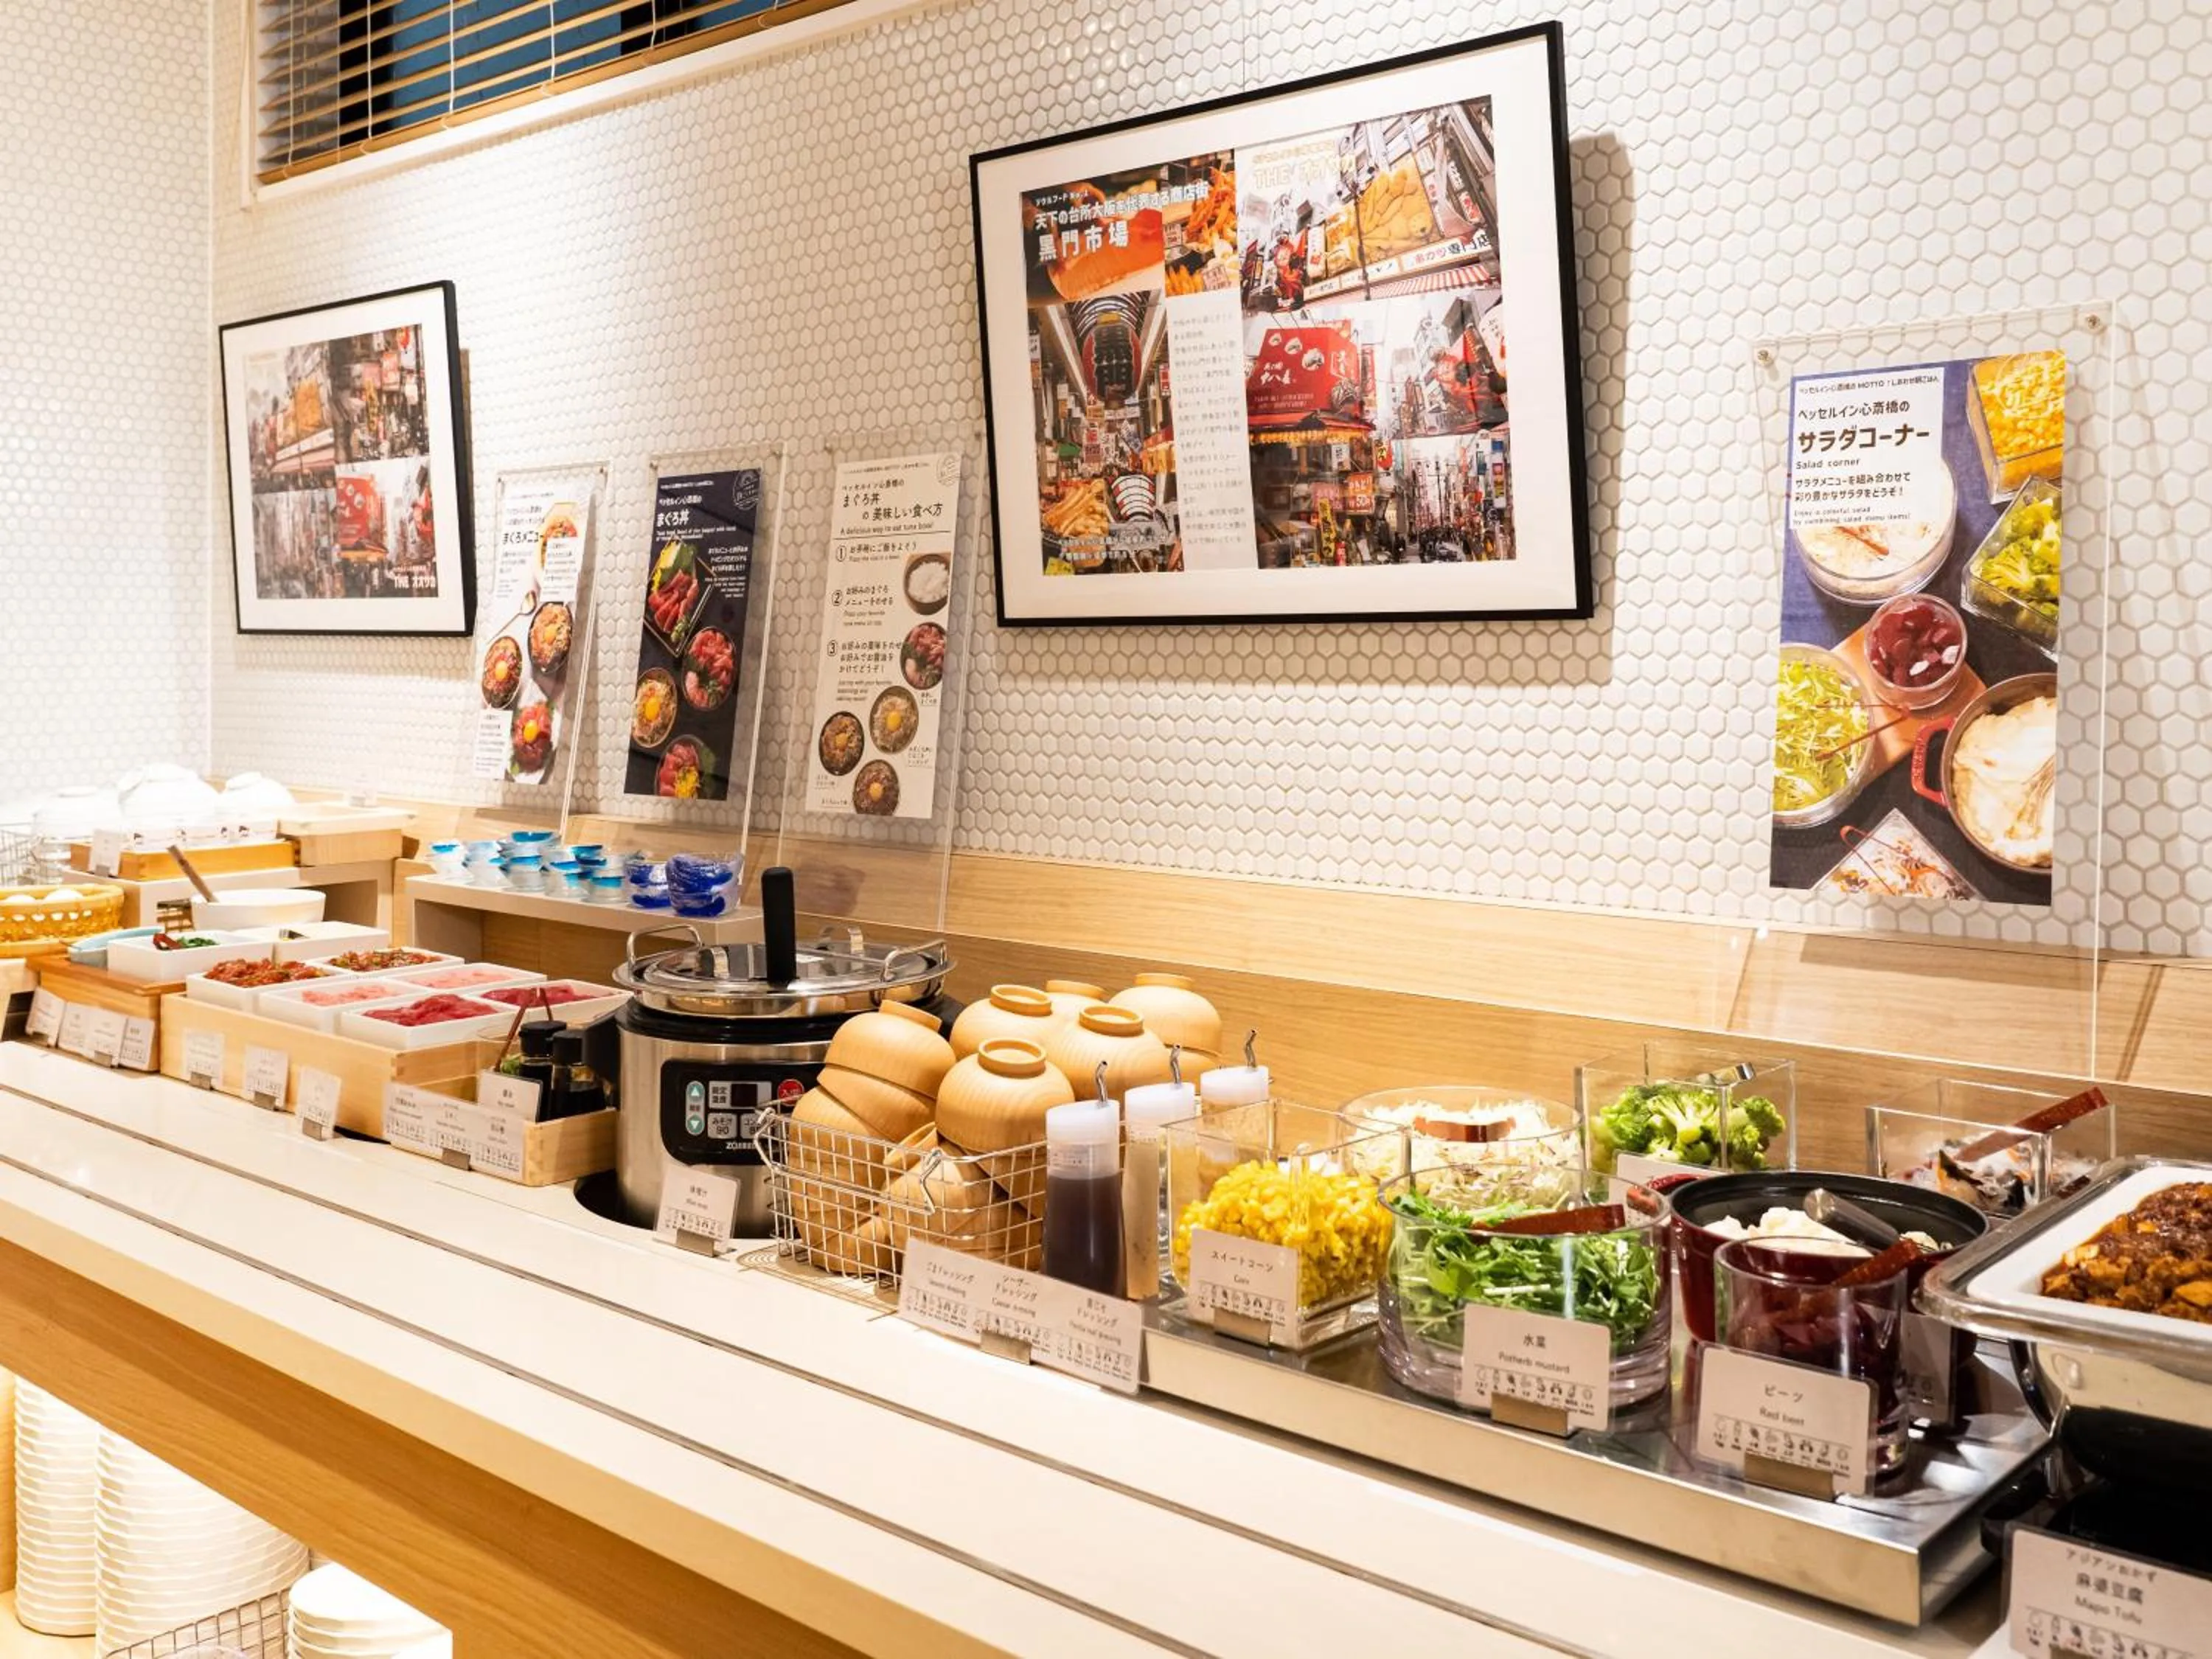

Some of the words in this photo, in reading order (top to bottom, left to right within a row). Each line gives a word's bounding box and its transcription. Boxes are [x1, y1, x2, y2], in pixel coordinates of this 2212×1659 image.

[1038, 220, 1130, 261] 黒門市場
[1798, 422, 1930, 453] サラダコーナー
[1795, 459, 1823, 470] Salad
[1828, 458, 1860, 467] corner
[843, 493, 880, 507] まぐろ丼
[656, 508, 689, 527] まぐろ丼
[716, 1127, 728, 1135] 90
[1523, 1333, 1546, 1349] 水菜
[1534, 1359, 1571, 1374] mustard
[1764, 1384, 1804, 1402] ビーツ
[1759, 1405, 1779, 1422] Red
